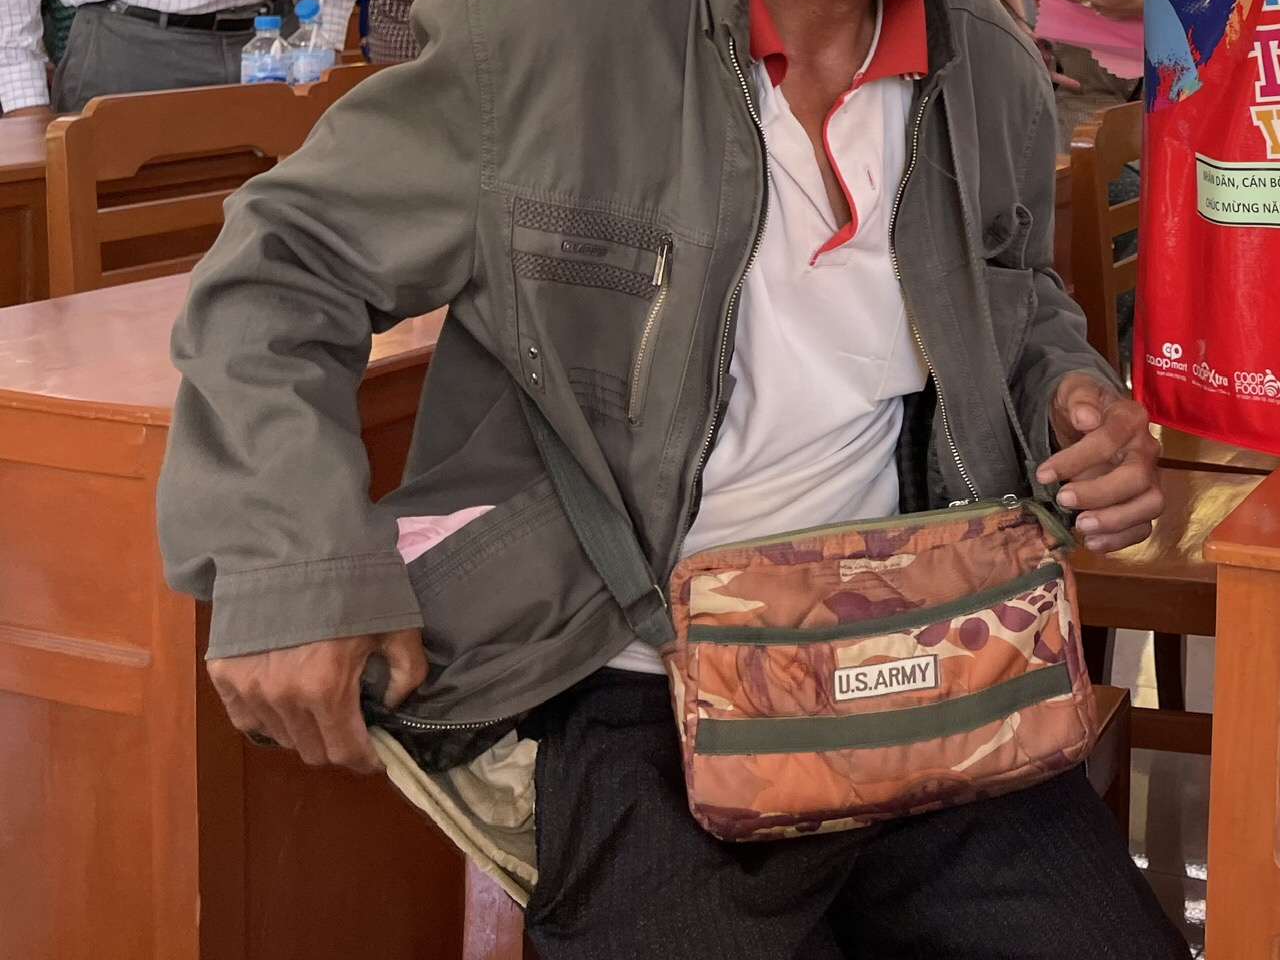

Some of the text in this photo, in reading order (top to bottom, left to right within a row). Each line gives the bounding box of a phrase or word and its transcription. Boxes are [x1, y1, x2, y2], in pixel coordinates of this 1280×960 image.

[1215, 174, 1239, 189] DÂN,
[1241, 174, 1267, 188] CÁN
[1221, 200, 1260, 213] MỪNG
[1235, 382, 1265, 395] FOOD
